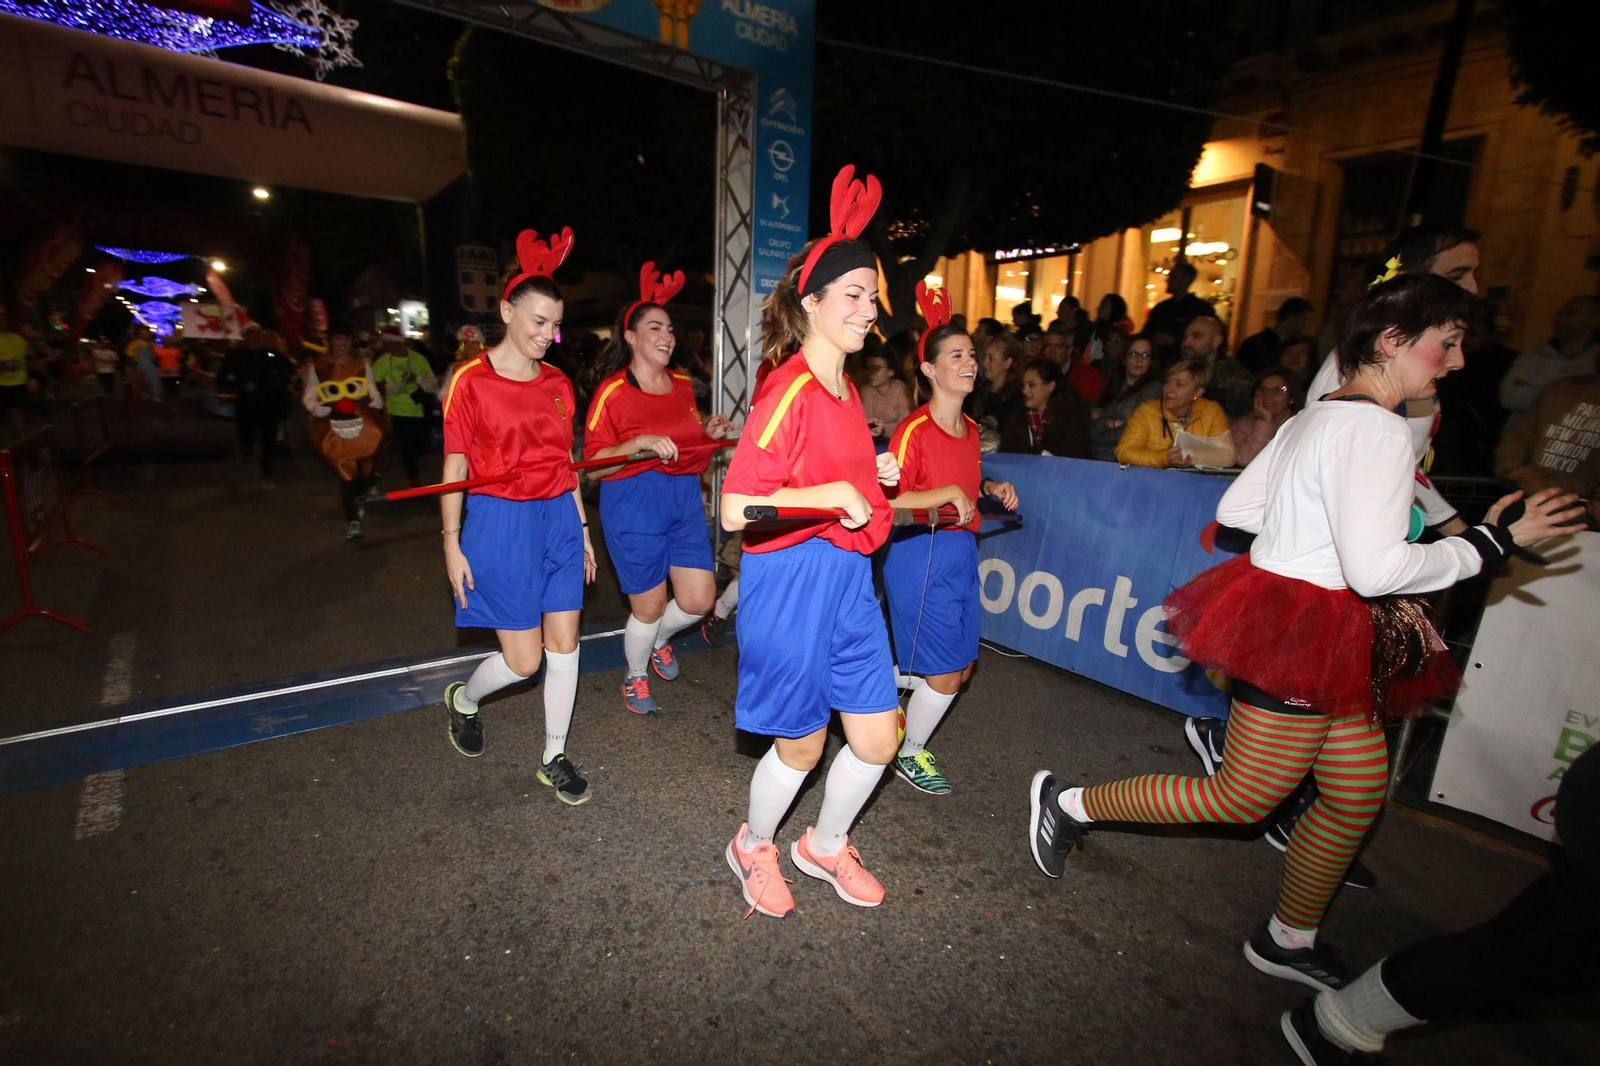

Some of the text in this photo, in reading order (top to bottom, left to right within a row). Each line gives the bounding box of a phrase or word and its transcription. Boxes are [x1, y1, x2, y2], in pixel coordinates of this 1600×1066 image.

[735, 21, 788, 52] CIUDAD
[64, 52, 314, 134] ALMERÍA
[65, 101, 203, 145] CIUDAD
[773, 172, 789, 182] OPEL
[757, 248, 785, 259] SALINAS
[769, 238, 791, 249] GRUPO
[1545, 424, 1576, 441] NEW
[1543, 439, 1592, 461] LONDON
[1539, 452, 1579, 473] TOKYO
